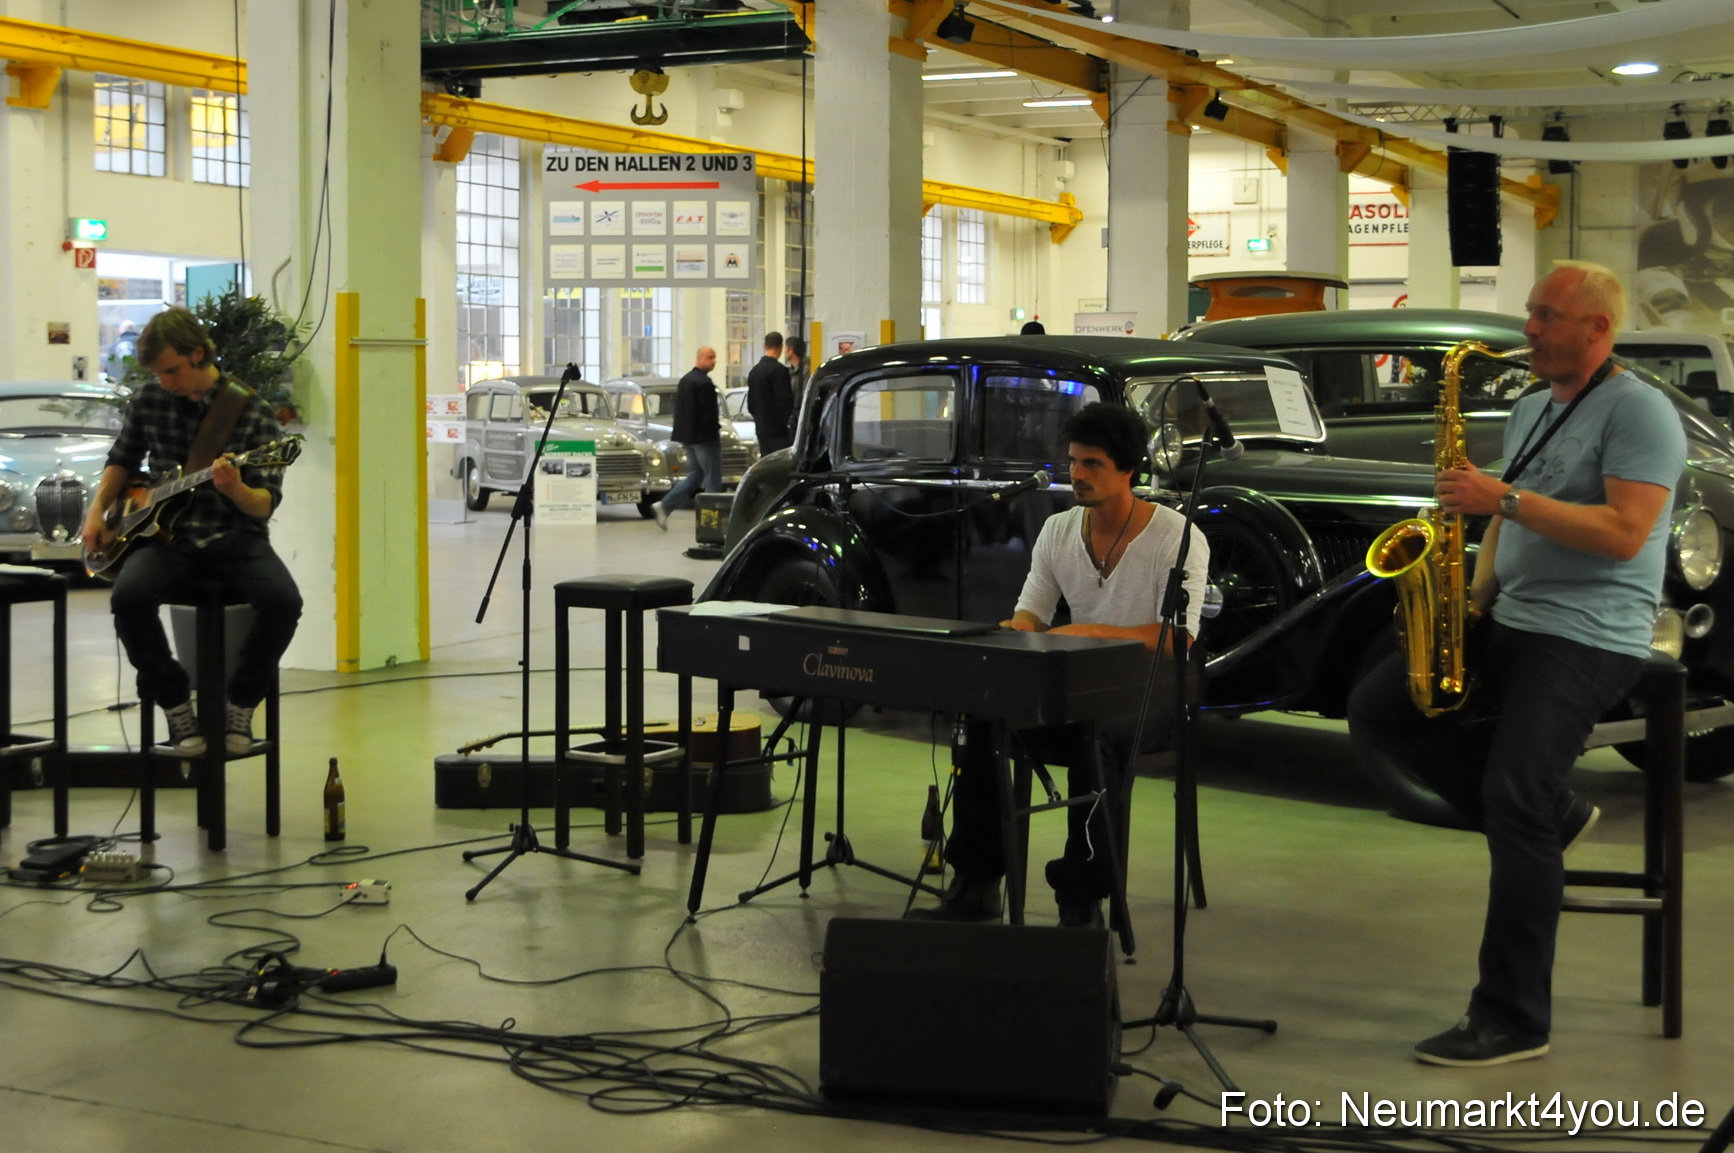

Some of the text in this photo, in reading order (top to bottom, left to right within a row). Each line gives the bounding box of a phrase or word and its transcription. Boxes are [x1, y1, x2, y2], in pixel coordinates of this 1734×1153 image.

[546, 155, 753, 172] ZU DEN HALLEN 2 UND 3
[803, 652, 874, 683] Clavinova
